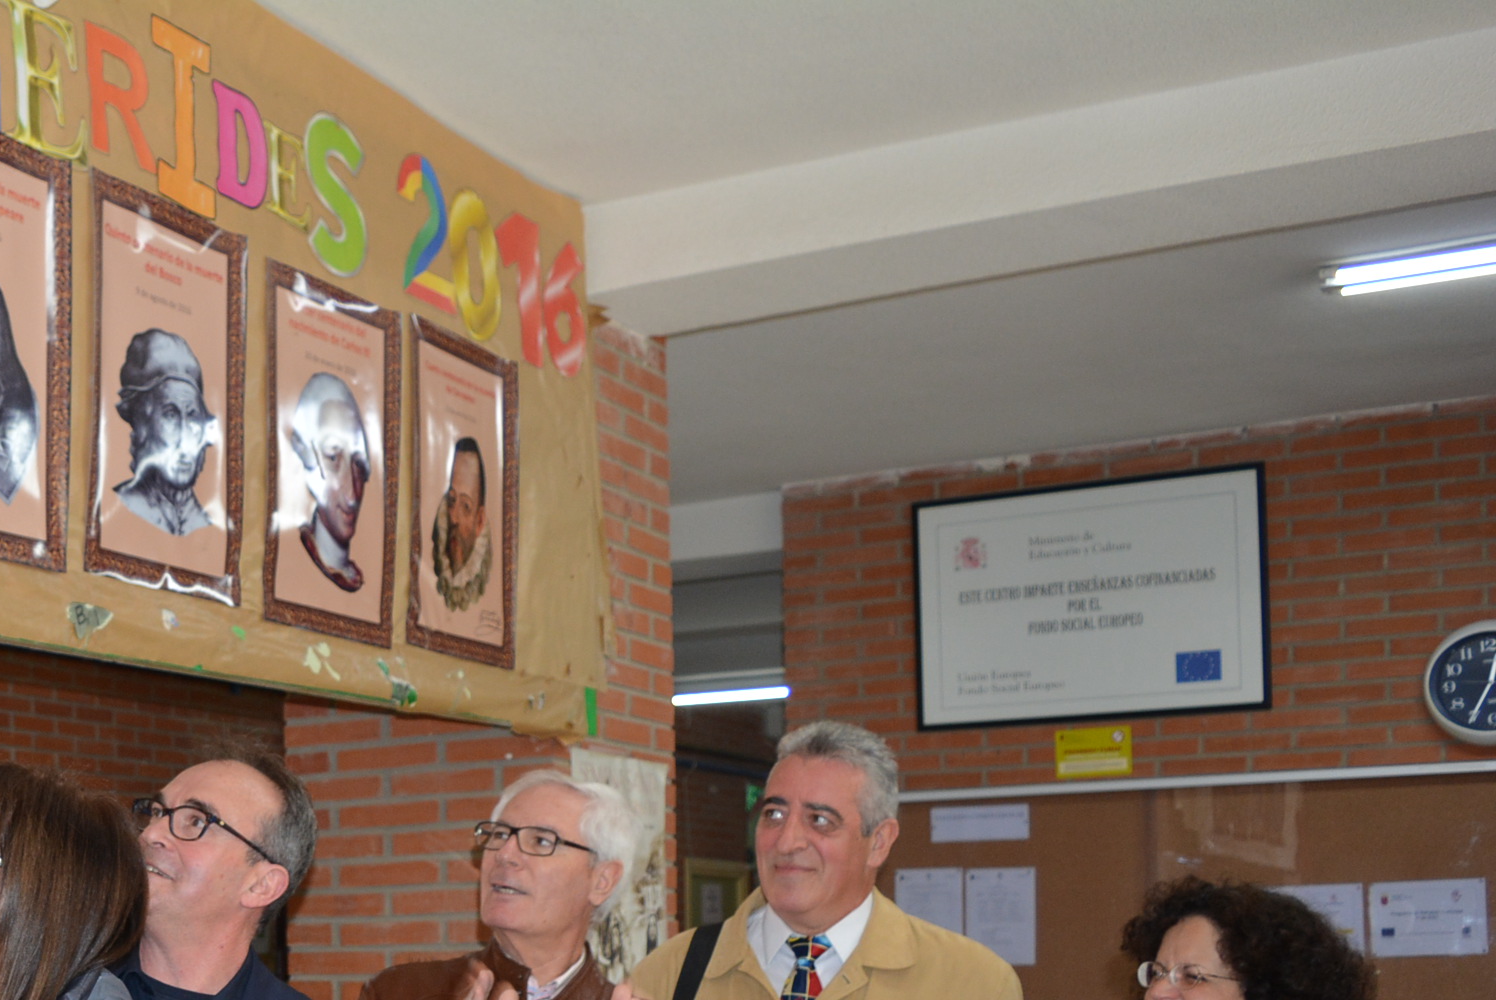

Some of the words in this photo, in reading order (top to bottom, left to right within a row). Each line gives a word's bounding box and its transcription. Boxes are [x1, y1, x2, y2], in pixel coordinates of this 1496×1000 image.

[7, 188, 41, 210] muerte
[396, 151, 586, 378] 2016
[1028, 530, 1082, 548] Ministerio
[1083, 530, 1095, 543] de
[959, 590, 982, 606] ESTE
[984, 586, 1022, 603] CENTRO
[1023, 581, 1065, 600] IMPARTE
[1067, 574, 1134, 597] ENSEÑANZAS
[1135, 567, 1217, 589] COFINANCIADAS
[1067, 598, 1088, 614] POR
[1088, 597, 1103, 612] EL
[1027, 620, 1059, 636] FONDO
[1060, 616, 1097, 633] SOCIAL
[1099, 612, 1144, 630] EUROPEO
[1460, 647, 1473, 660] 11
[1480, 638, 1496, 653] 12
[1446, 662, 1463, 677] 10
[957, 682, 989, 696] Fondo
[1442, 680, 1457, 694] 9
[1450, 697, 1465, 711] 8
